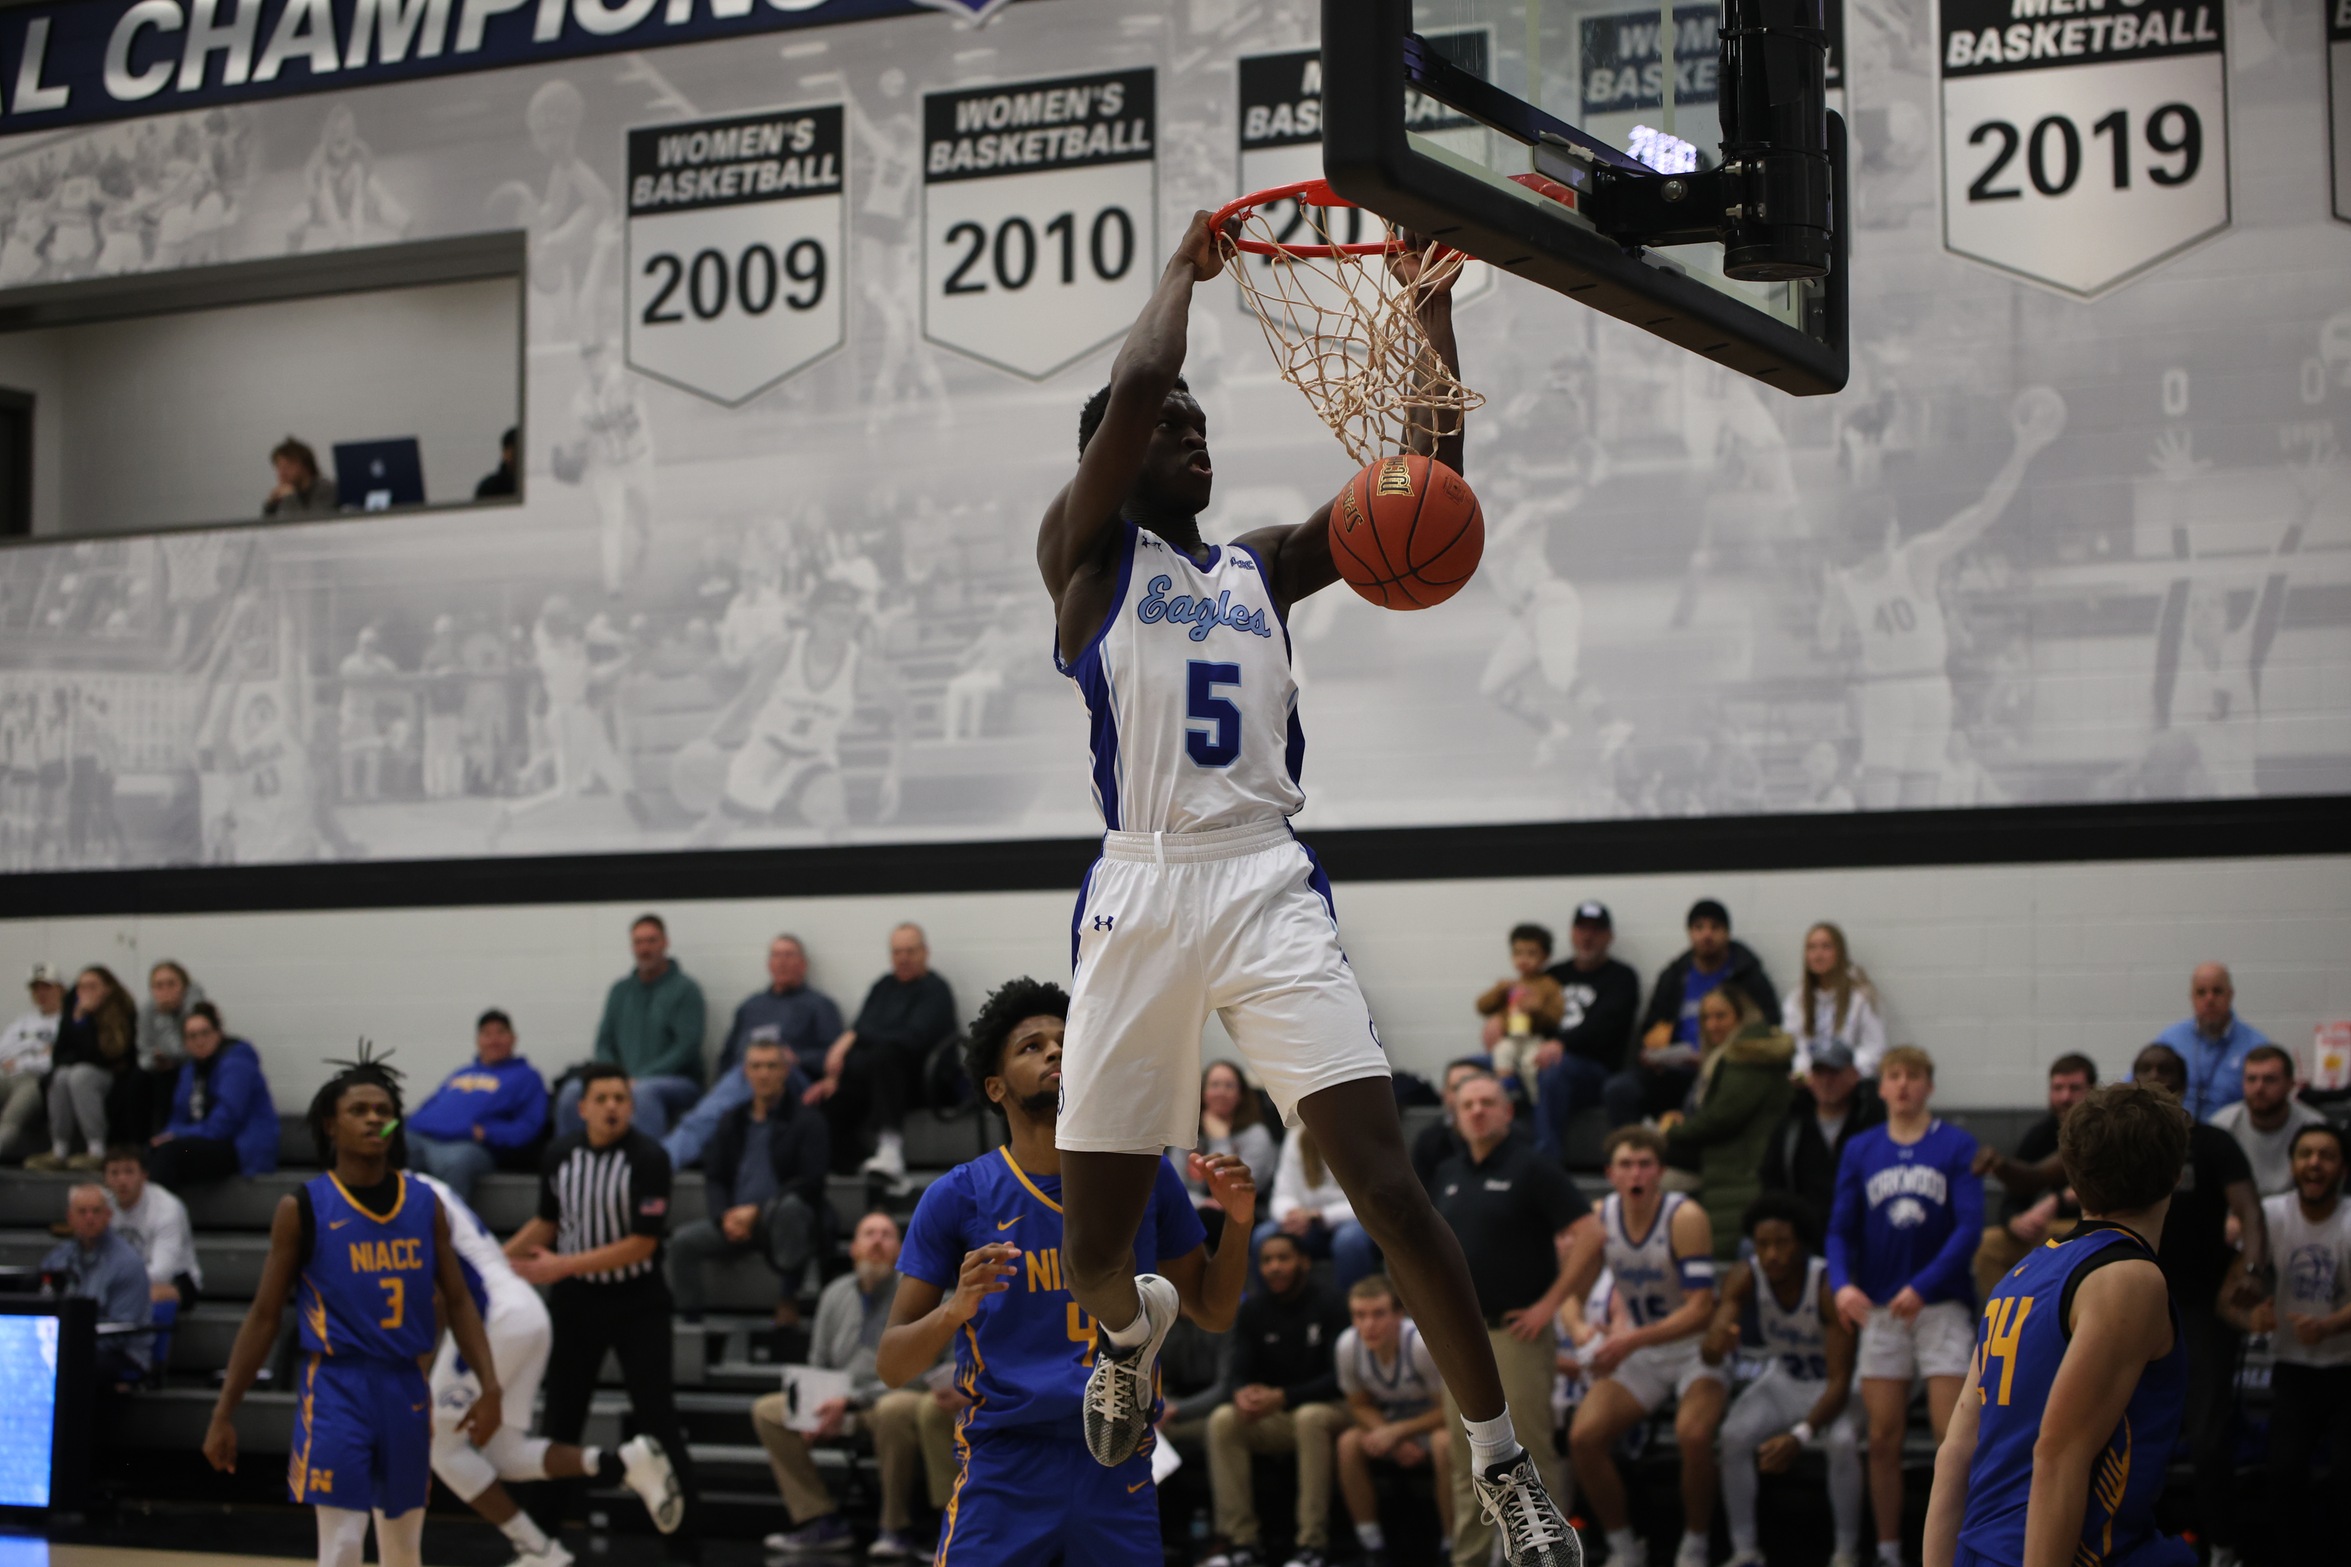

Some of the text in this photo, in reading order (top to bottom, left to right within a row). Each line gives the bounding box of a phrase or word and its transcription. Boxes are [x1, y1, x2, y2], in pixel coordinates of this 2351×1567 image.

[10, 0, 831, 114] L CHAMP
[1946, 6, 2218, 68] BASKETBALL
[956, 82, 1125, 134] WOMEN'S
[657, 117, 816, 168] WOMEN'S
[928, 118, 1151, 175] BASKETBALL
[1967, 101, 2204, 203] 2019
[631, 153, 839, 208] BASKETBALL
[642, 237, 827, 326] 2009
[943, 205, 1135, 296] 2010
[1137, 574, 1272, 642] Eagles
[1184, 658, 1242, 769] 5
[350, 1238, 423, 1273] NIACC
[379, 1277, 405, 1330] 3
[1066, 1301, 1099, 1368] 4
